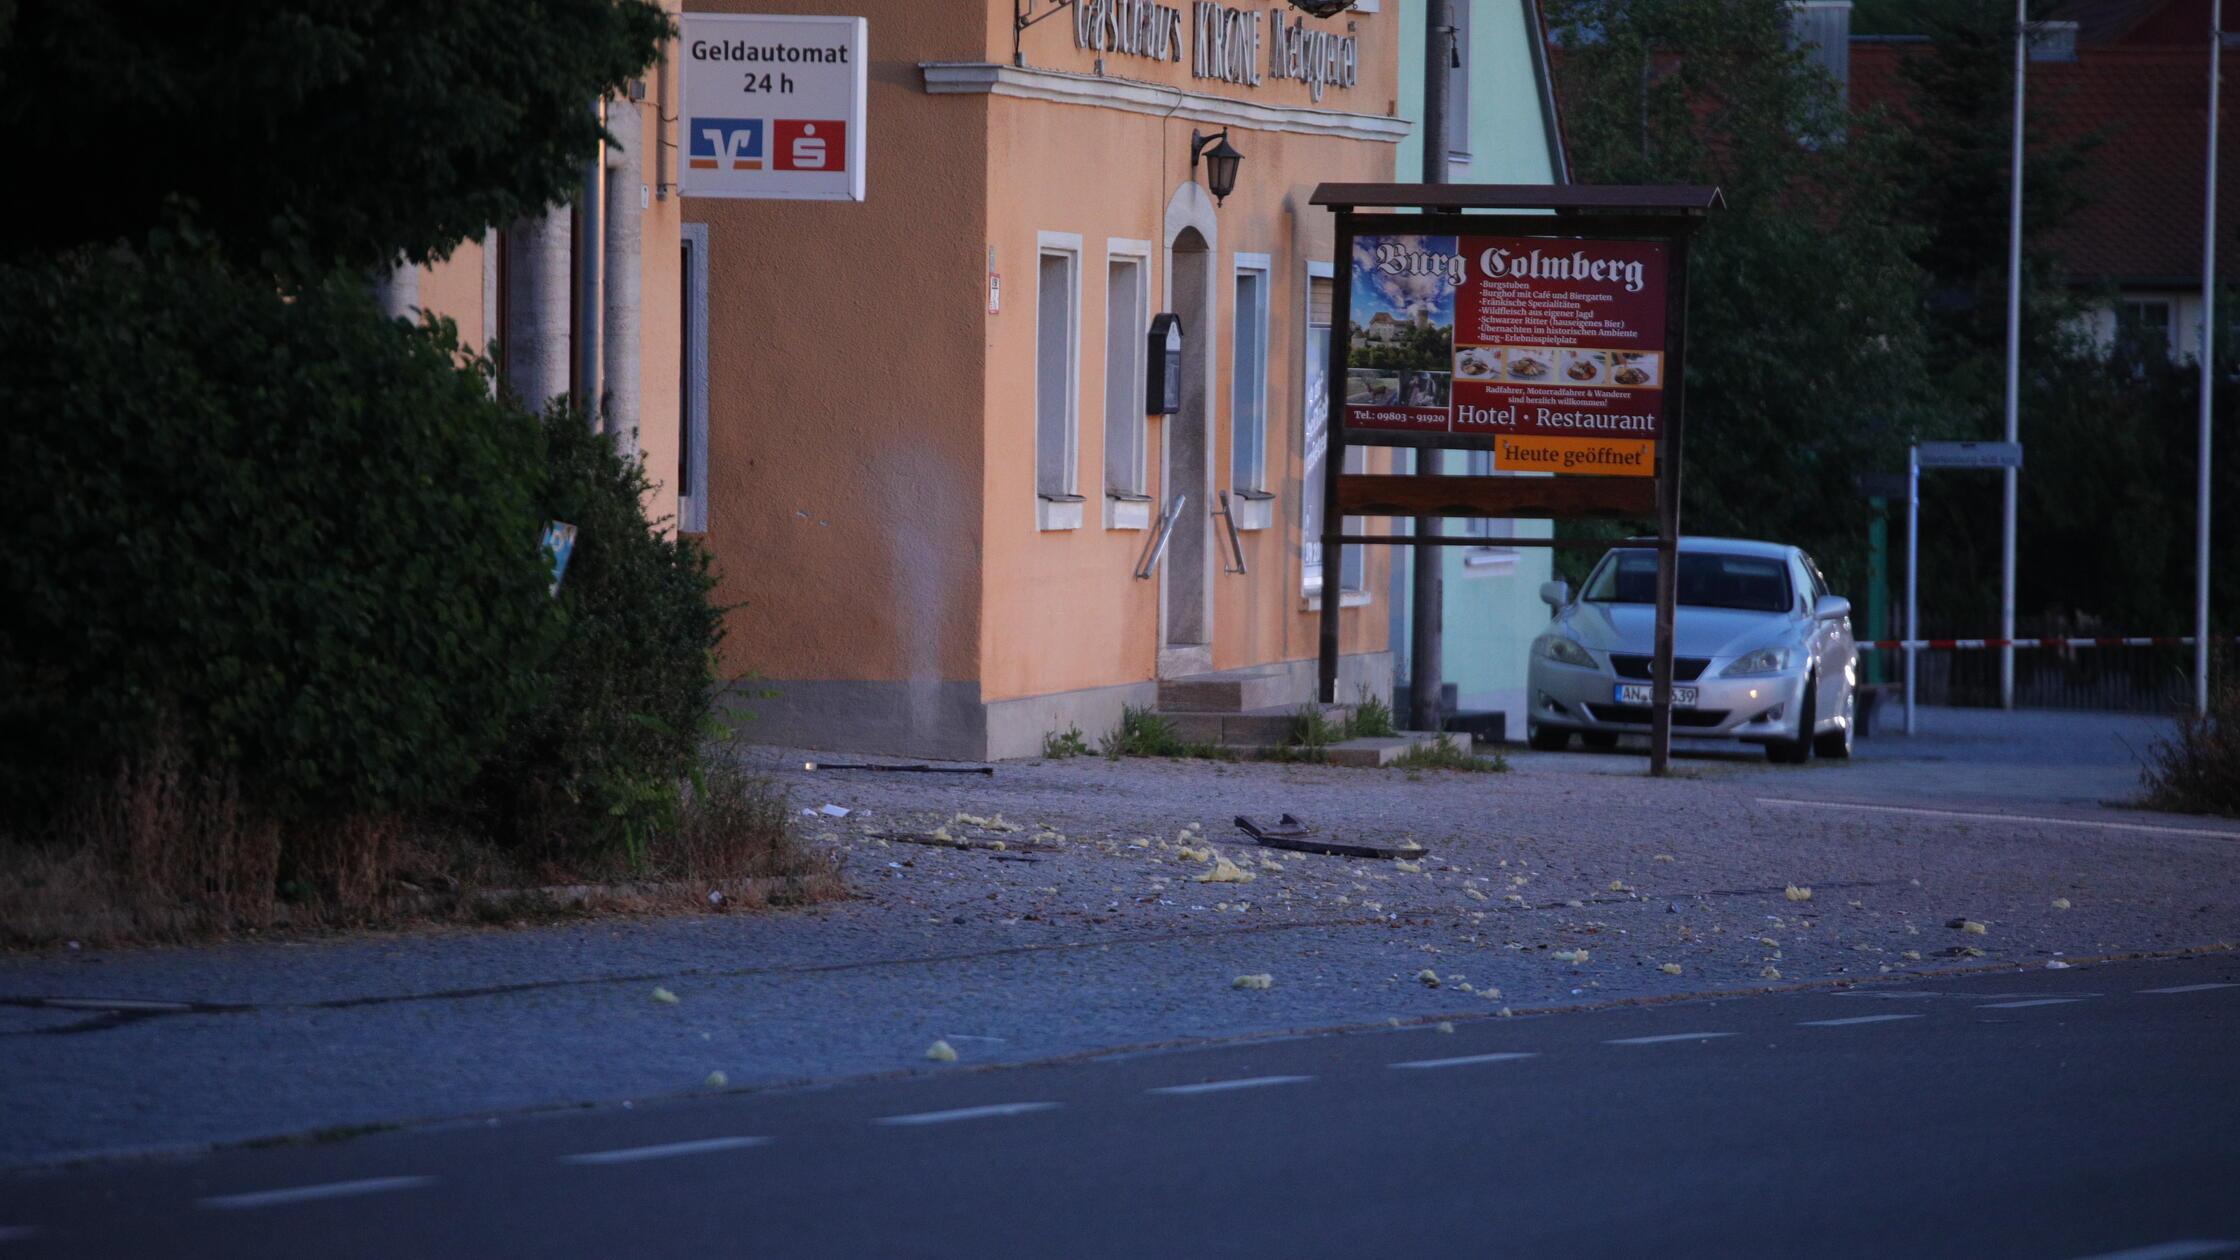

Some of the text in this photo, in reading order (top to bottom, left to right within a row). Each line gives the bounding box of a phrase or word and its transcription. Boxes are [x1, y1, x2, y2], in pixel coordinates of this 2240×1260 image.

[692, 40, 848, 64] Geldautomat
[743, 73, 794, 94] 24 h
[1374, 242, 1645, 292] Burg Colmberg
[1482, 288, 1515, 299] Burghof
[1517, 290, 1531, 298] mit
[1533, 290, 1551, 299] Café
[1569, 292, 1612, 303] Biergarten
[1482, 298, 1580, 309] Fränkische Spezialitäten
[1481, 306, 1527, 316] Wildfleisch
[1544, 309, 1574, 319] eigener
[1576, 310, 1594, 320] Jagd
[1481, 316, 1625, 329] Schwarzer Ritter (hauseigenes Bier)
[1480, 323, 1638, 337] Übernachten im historischen Ambiente
[1480, 333, 1577, 345] Burg-Erlebnisspielplatz
[1485, 385, 1632, 399] Radfahrer, Motorradfahrer & Wanderer
[1507, 396, 1609, 407] sind herzlich willkommen!
[1353, 410, 1375, 420] Tel.:
[1376, 411, 1408, 423] 09803
[1416, 413, 1445, 424] 91920
[1458, 404, 1655, 431] Hotel Restaurant
[1504, 445, 1643, 468] Heute geöffnet
[1623, 686, 1640, 700] AN
